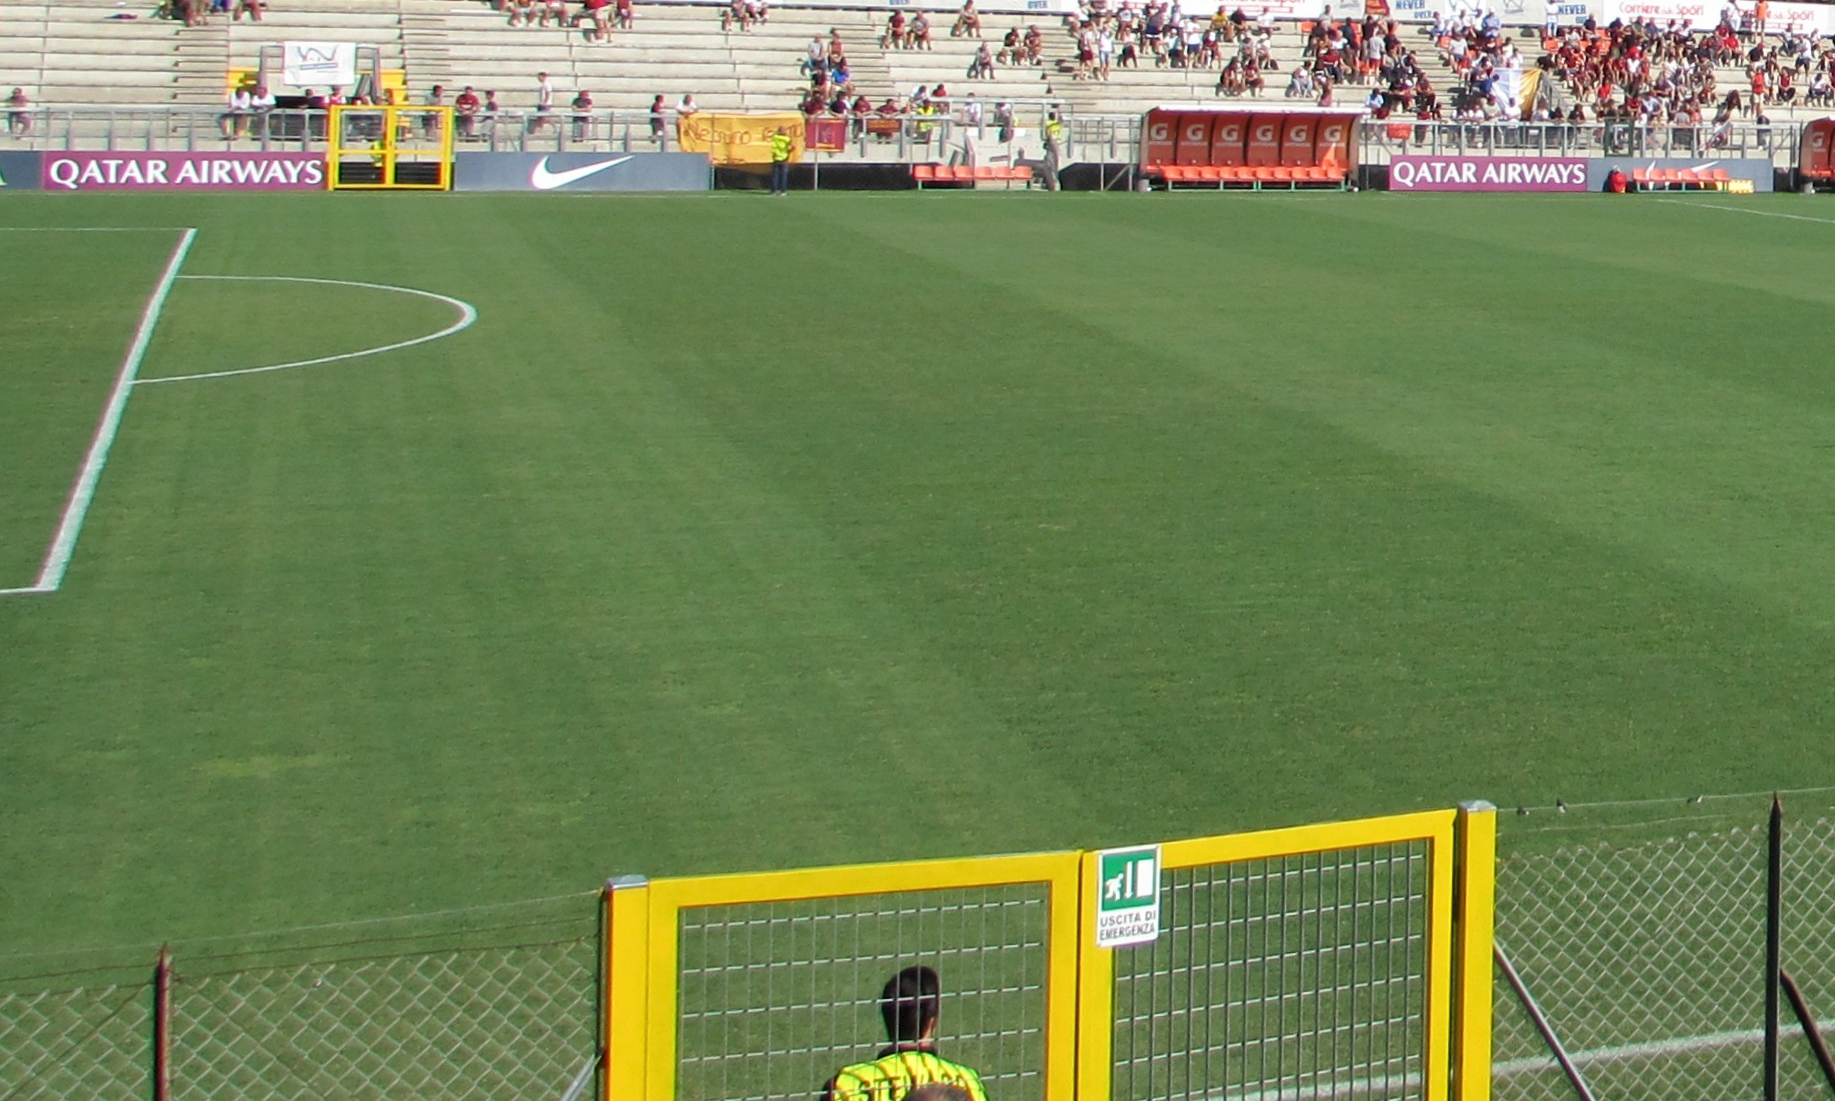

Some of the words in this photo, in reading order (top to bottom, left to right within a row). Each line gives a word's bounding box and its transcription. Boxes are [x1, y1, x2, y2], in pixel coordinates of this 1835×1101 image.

[50, 158, 169, 189] QATAR
[175, 158, 323, 185] AIRWAYS
[1393, 161, 1478, 188] QATAR
[1482, 162, 1586, 185] AIRWAYS
[1100, 911, 1141, 927] USCITA
[1145, 910, 1156, 921] DI
[1100, 922, 1155, 941] EMERGENZA
